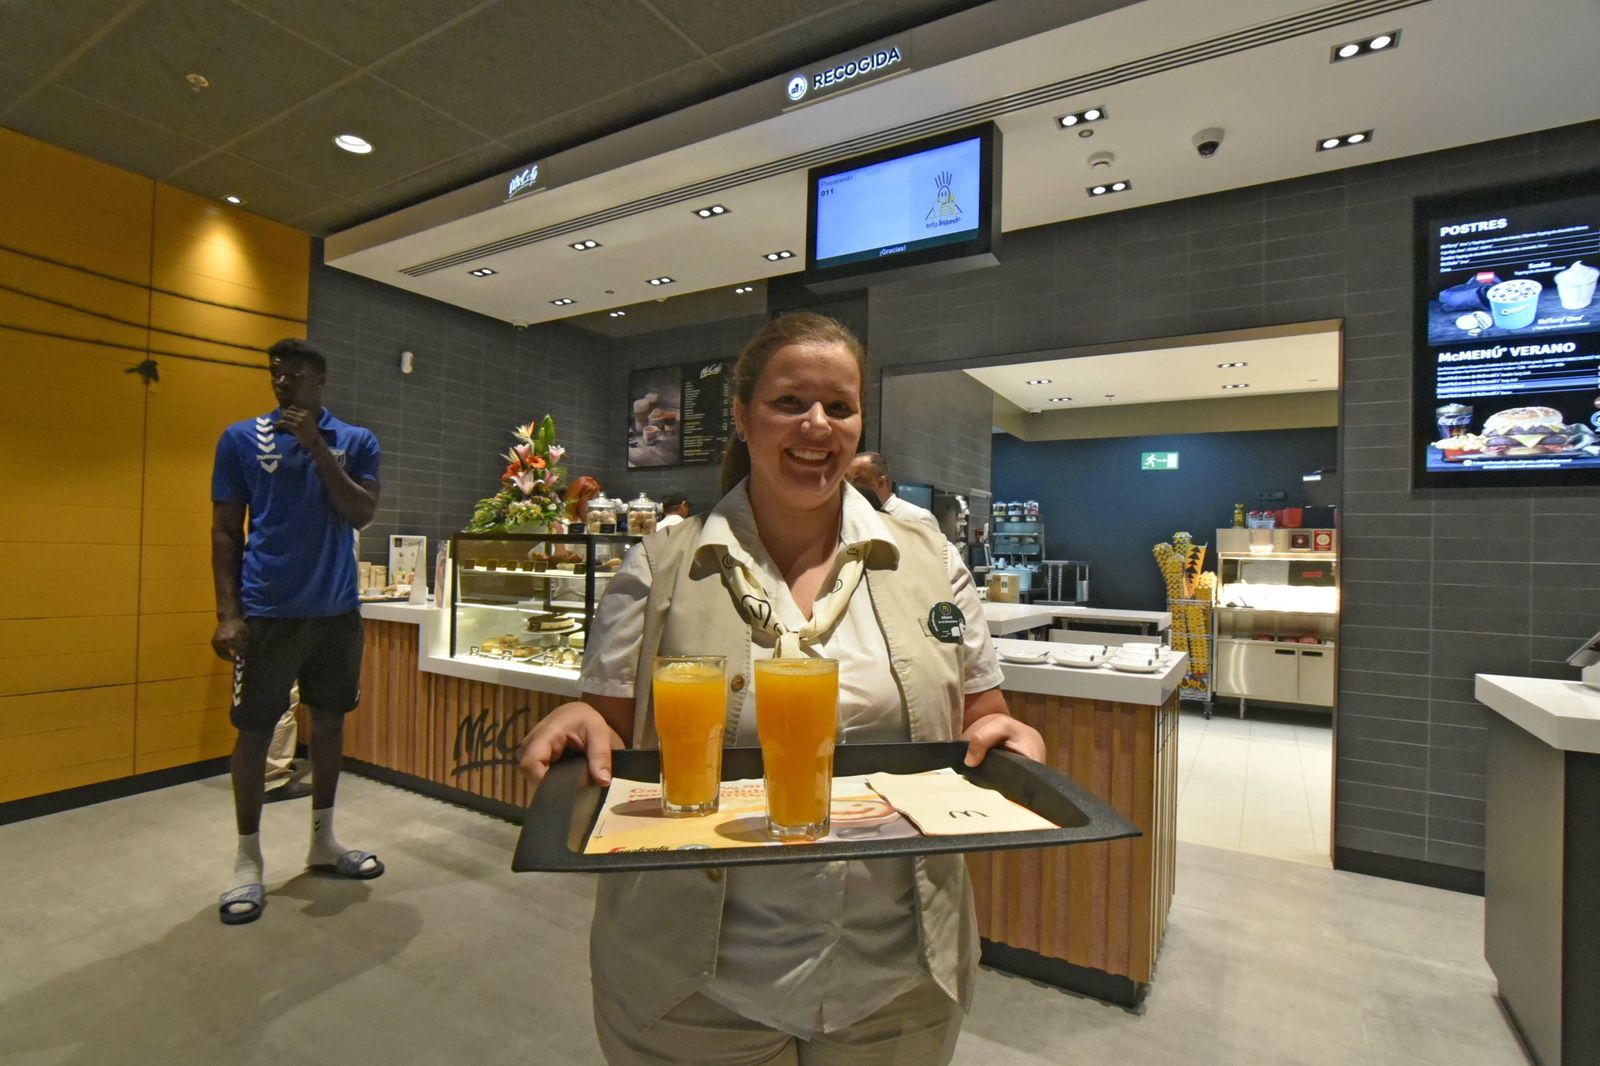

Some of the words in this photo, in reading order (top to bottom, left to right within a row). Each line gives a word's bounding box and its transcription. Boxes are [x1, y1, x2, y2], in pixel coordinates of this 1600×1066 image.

[813, 47, 901, 90] RECOGIDA
[820, 187, 834, 198] 011
[1440, 218, 1508, 237] POSTRES
[880, 244, 907, 257] ¡Gracias!
[1509, 342, 1576, 357] VERANO
